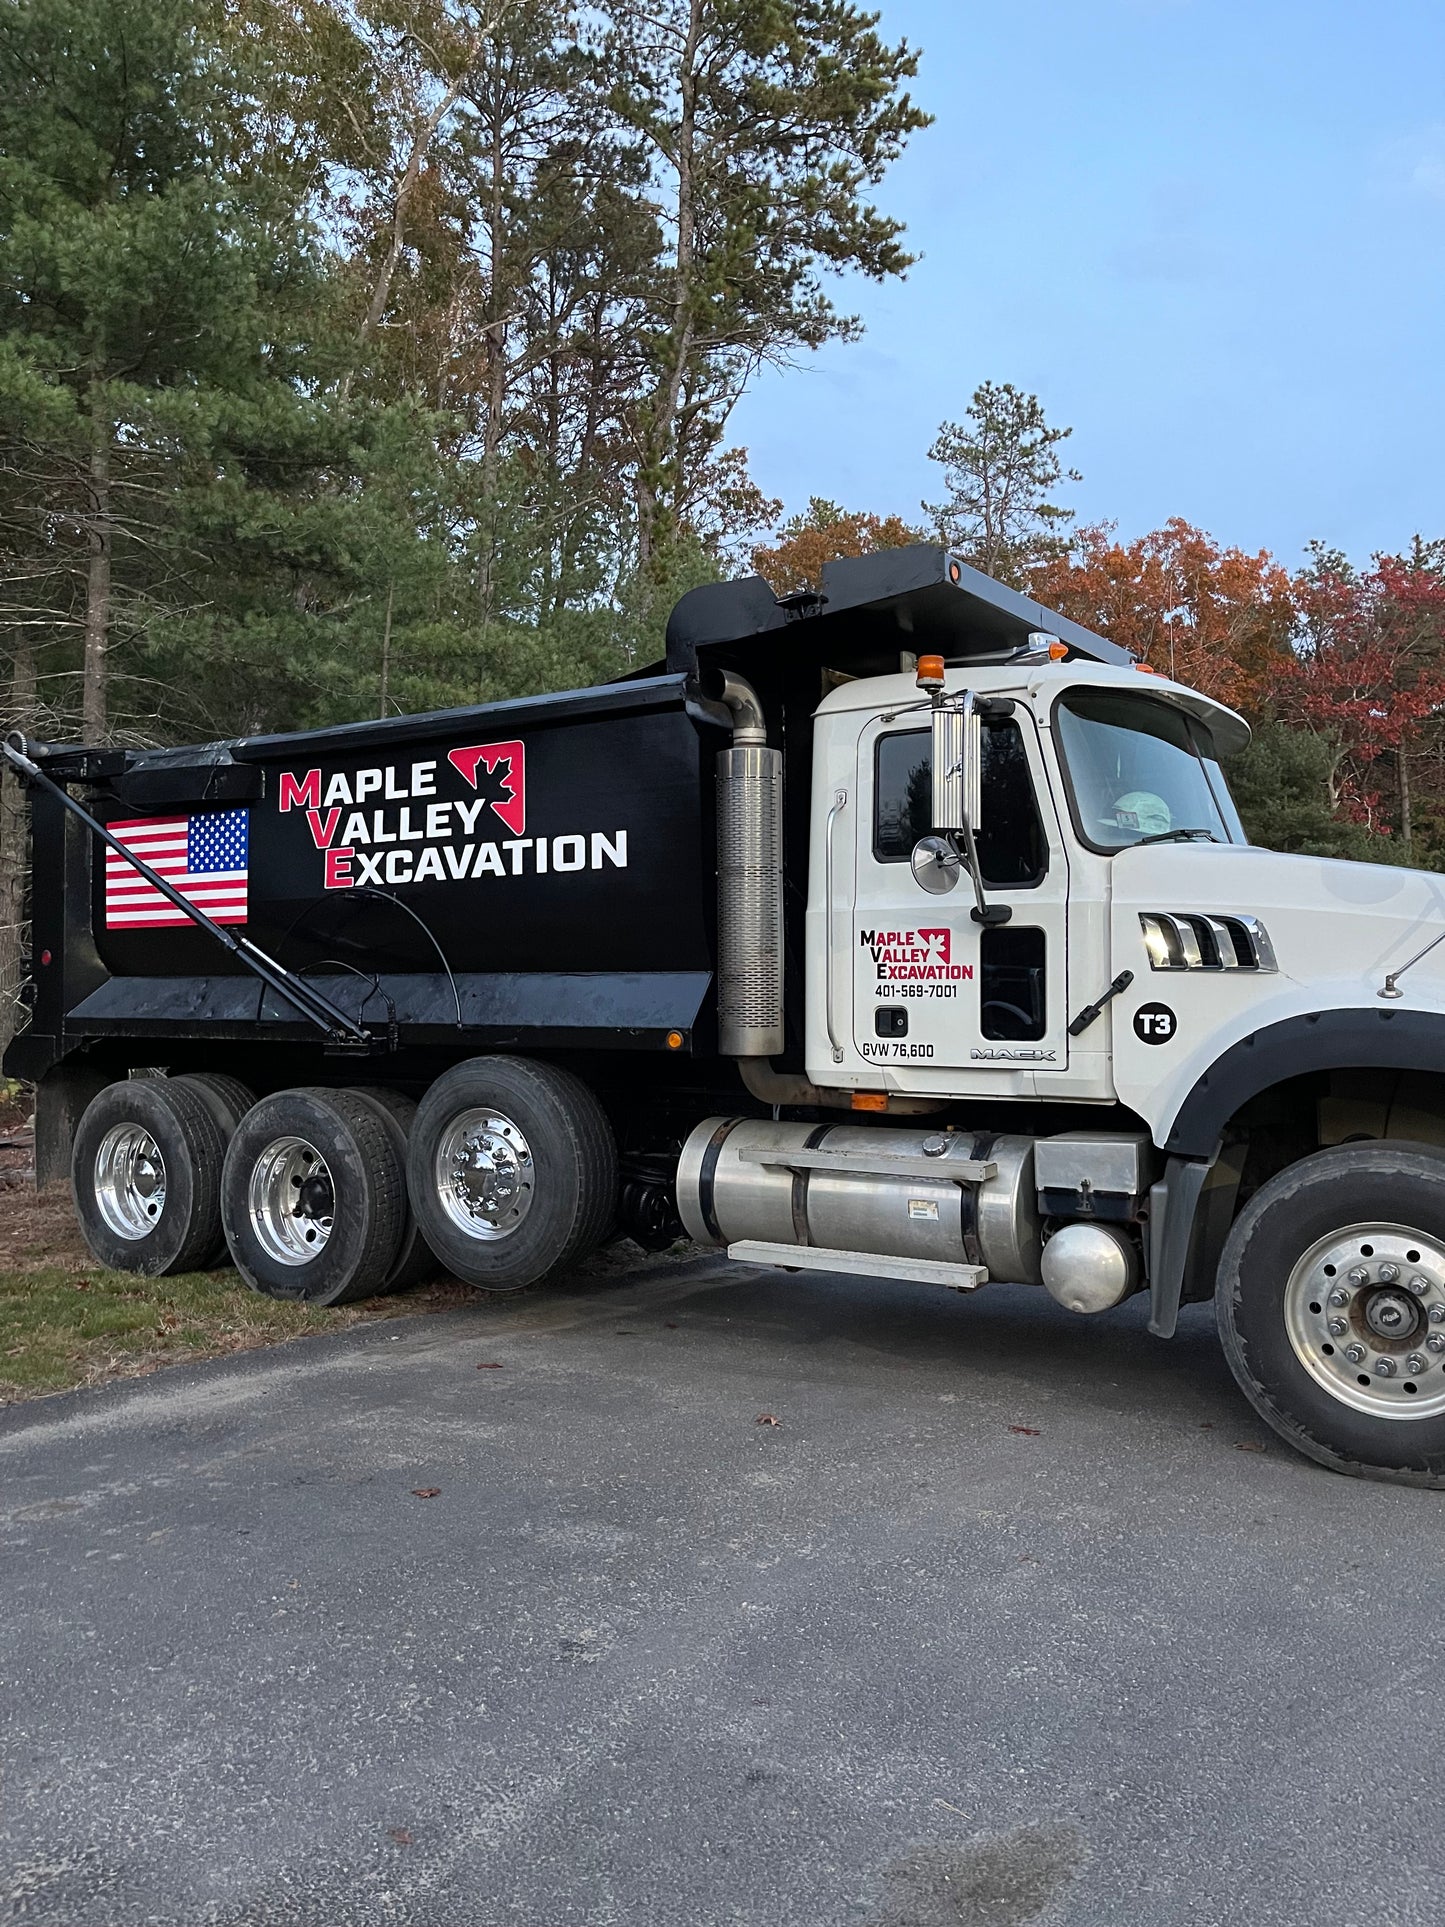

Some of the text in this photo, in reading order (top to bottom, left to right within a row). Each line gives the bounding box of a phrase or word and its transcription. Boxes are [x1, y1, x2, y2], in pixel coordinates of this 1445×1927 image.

[279, 761, 437, 812] MAPLE
[306, 798, 486, 849] VALLEY
[324, 830, 628, 889] EXCAVATION
[861, 930, 915, 946] MAPLE
[870, 947, 930, 963] VALLEY
[877, 963, 973, 980] EXCAVATION
[875, 985, 957, 997] 401-569-7001
[1139, 1014, 1170, 1035] T3
[863, 1043, 934, 1058] GVW 76,600
[970, 1049, 1056, 1061] MACK
